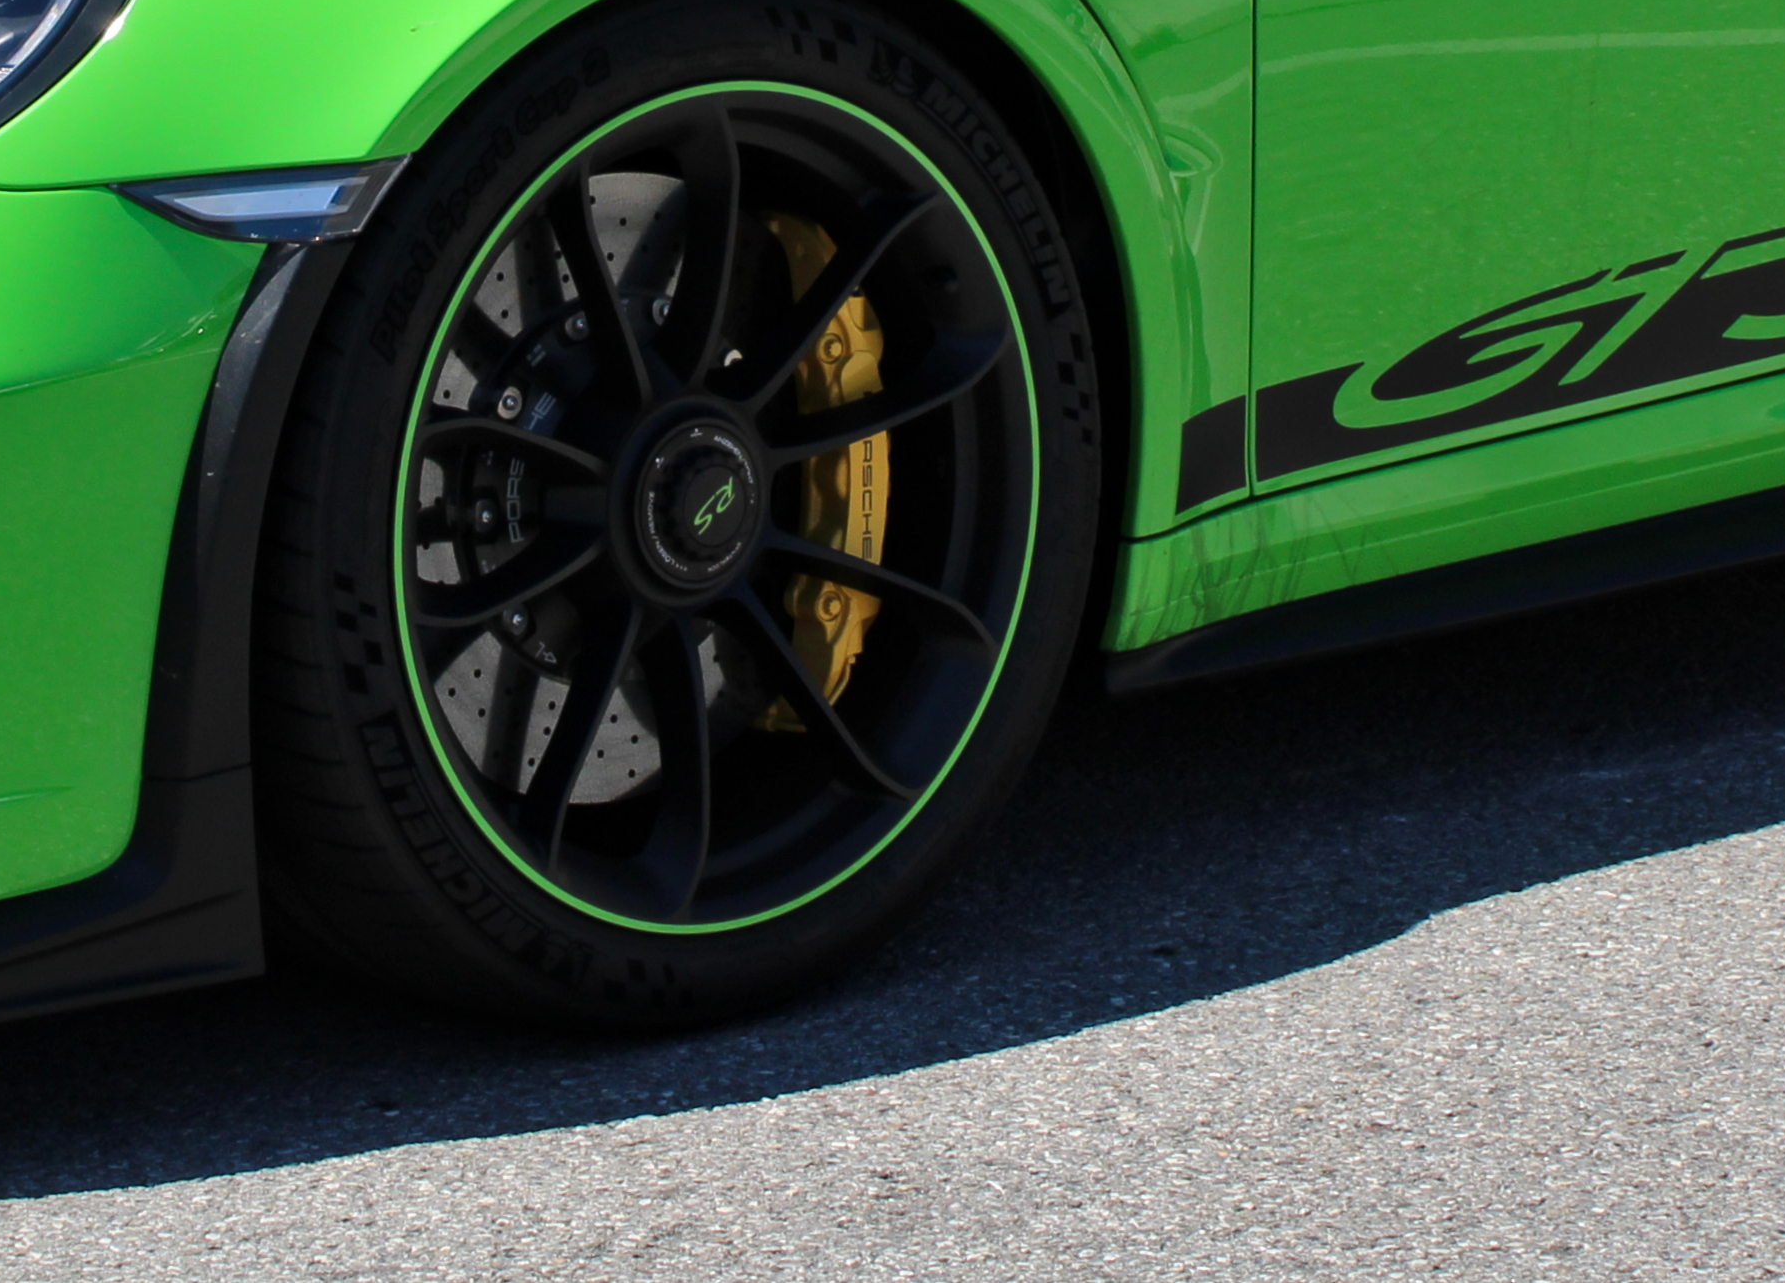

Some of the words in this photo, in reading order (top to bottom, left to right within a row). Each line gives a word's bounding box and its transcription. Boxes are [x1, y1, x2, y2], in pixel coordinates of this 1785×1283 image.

[919, 77, 1073, 306] MICHELIN
[693, 475, 735, 535] RS
[361, 725, 541, 953] MICHELIN
